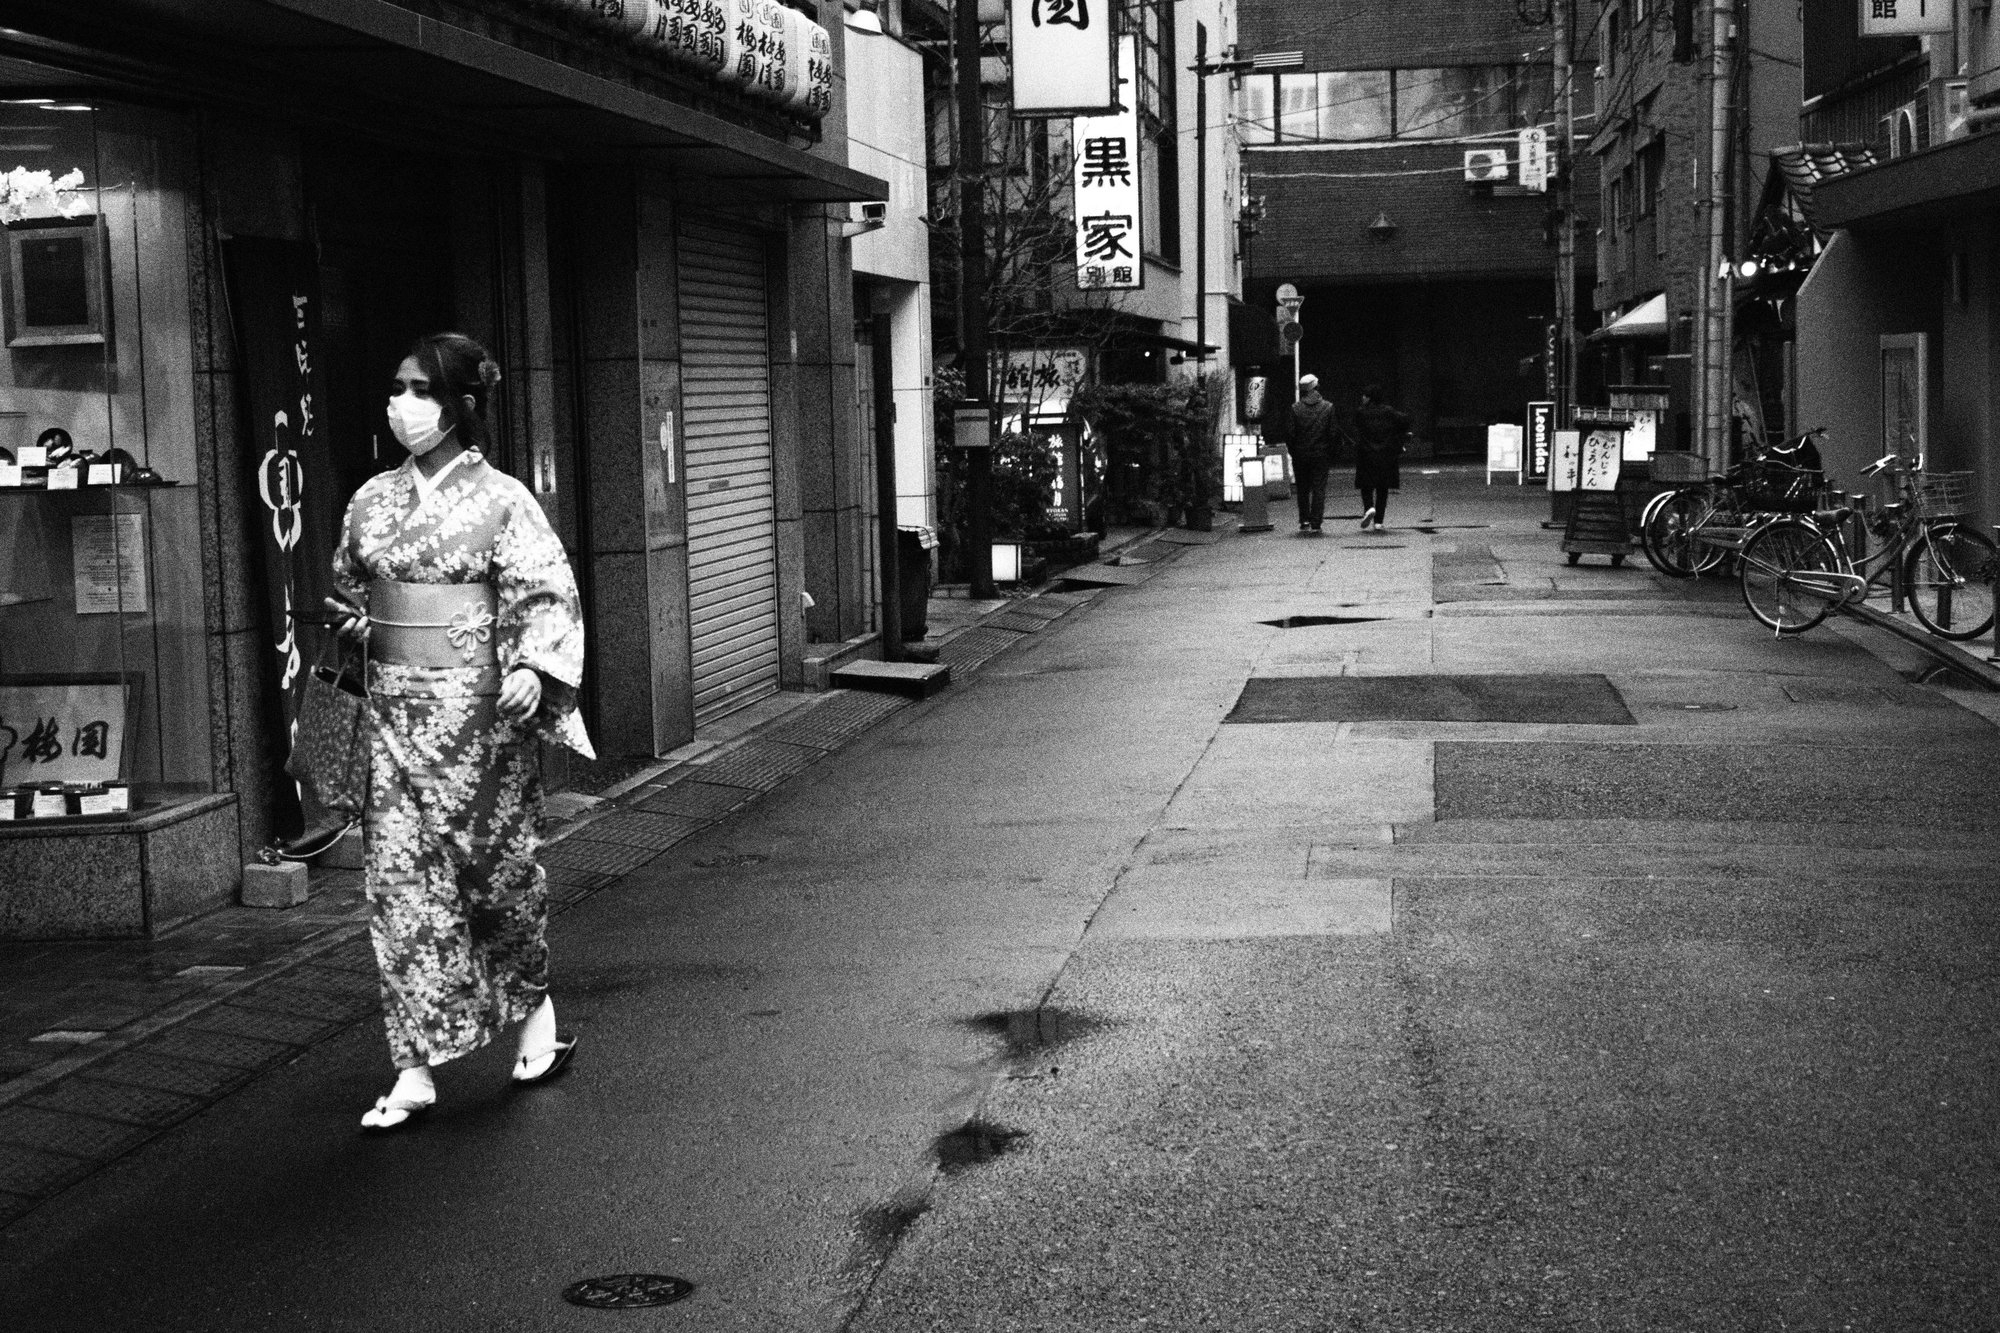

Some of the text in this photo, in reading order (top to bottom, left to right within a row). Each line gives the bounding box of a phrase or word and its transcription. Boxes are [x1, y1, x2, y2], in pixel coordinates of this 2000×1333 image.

[1535, 408, 1549, 474] Leonidas
[1586, 437, 1599, 487] ひょうたん
